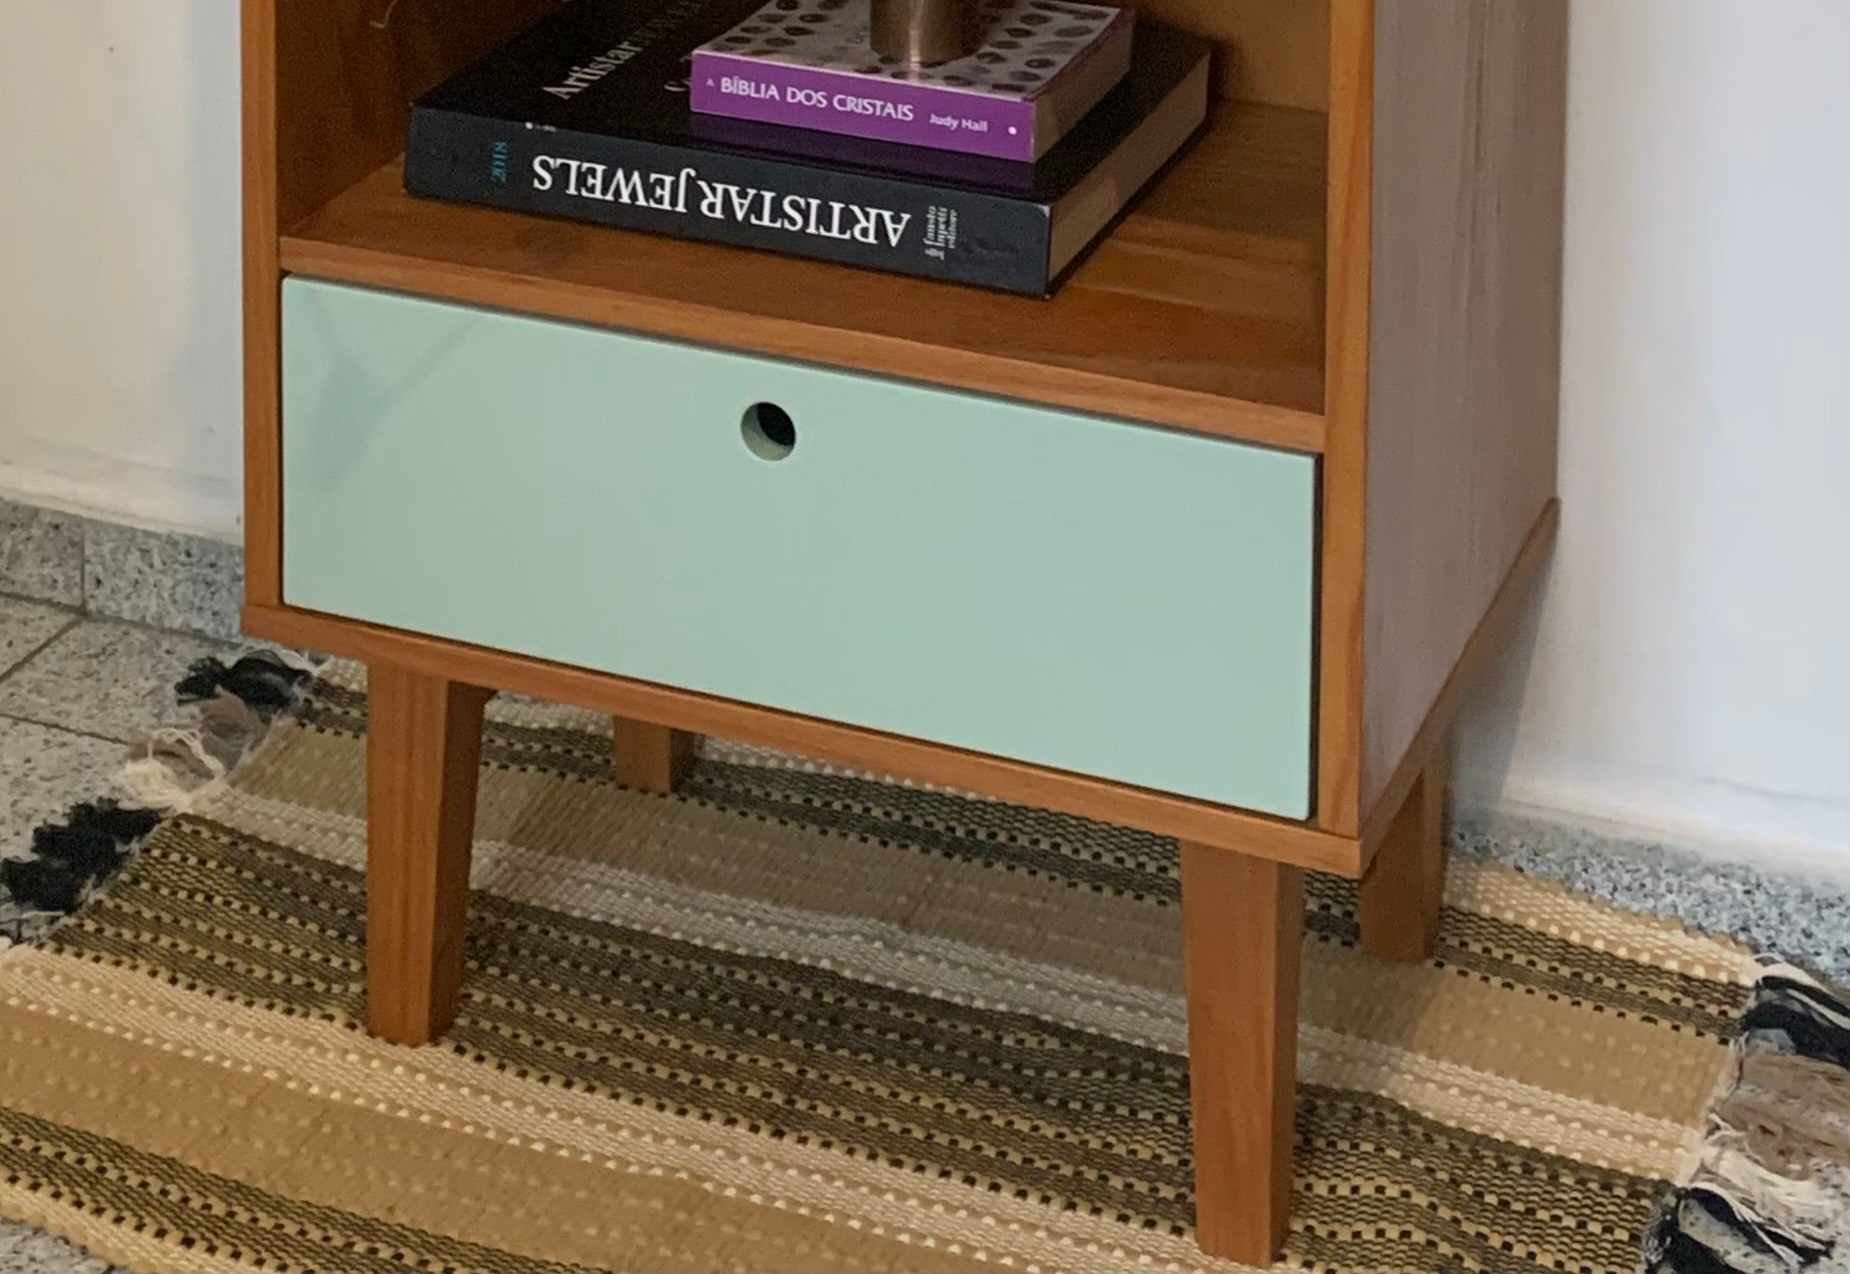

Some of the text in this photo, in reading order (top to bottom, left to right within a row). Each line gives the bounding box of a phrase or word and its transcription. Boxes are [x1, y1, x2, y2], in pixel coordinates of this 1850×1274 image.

[541, 40, 643, 101] Artistar
[720, 74, 781, 101] BÍBLIA
[785, 85, 828, 109] DOS
[832, 93, 914, 122] CRISTAIS
[929, 112, 958, 131] Judy
[961, 118, 988, 133] Hall
[532, 154, 911, 248] ARTISTAR JEWELS
